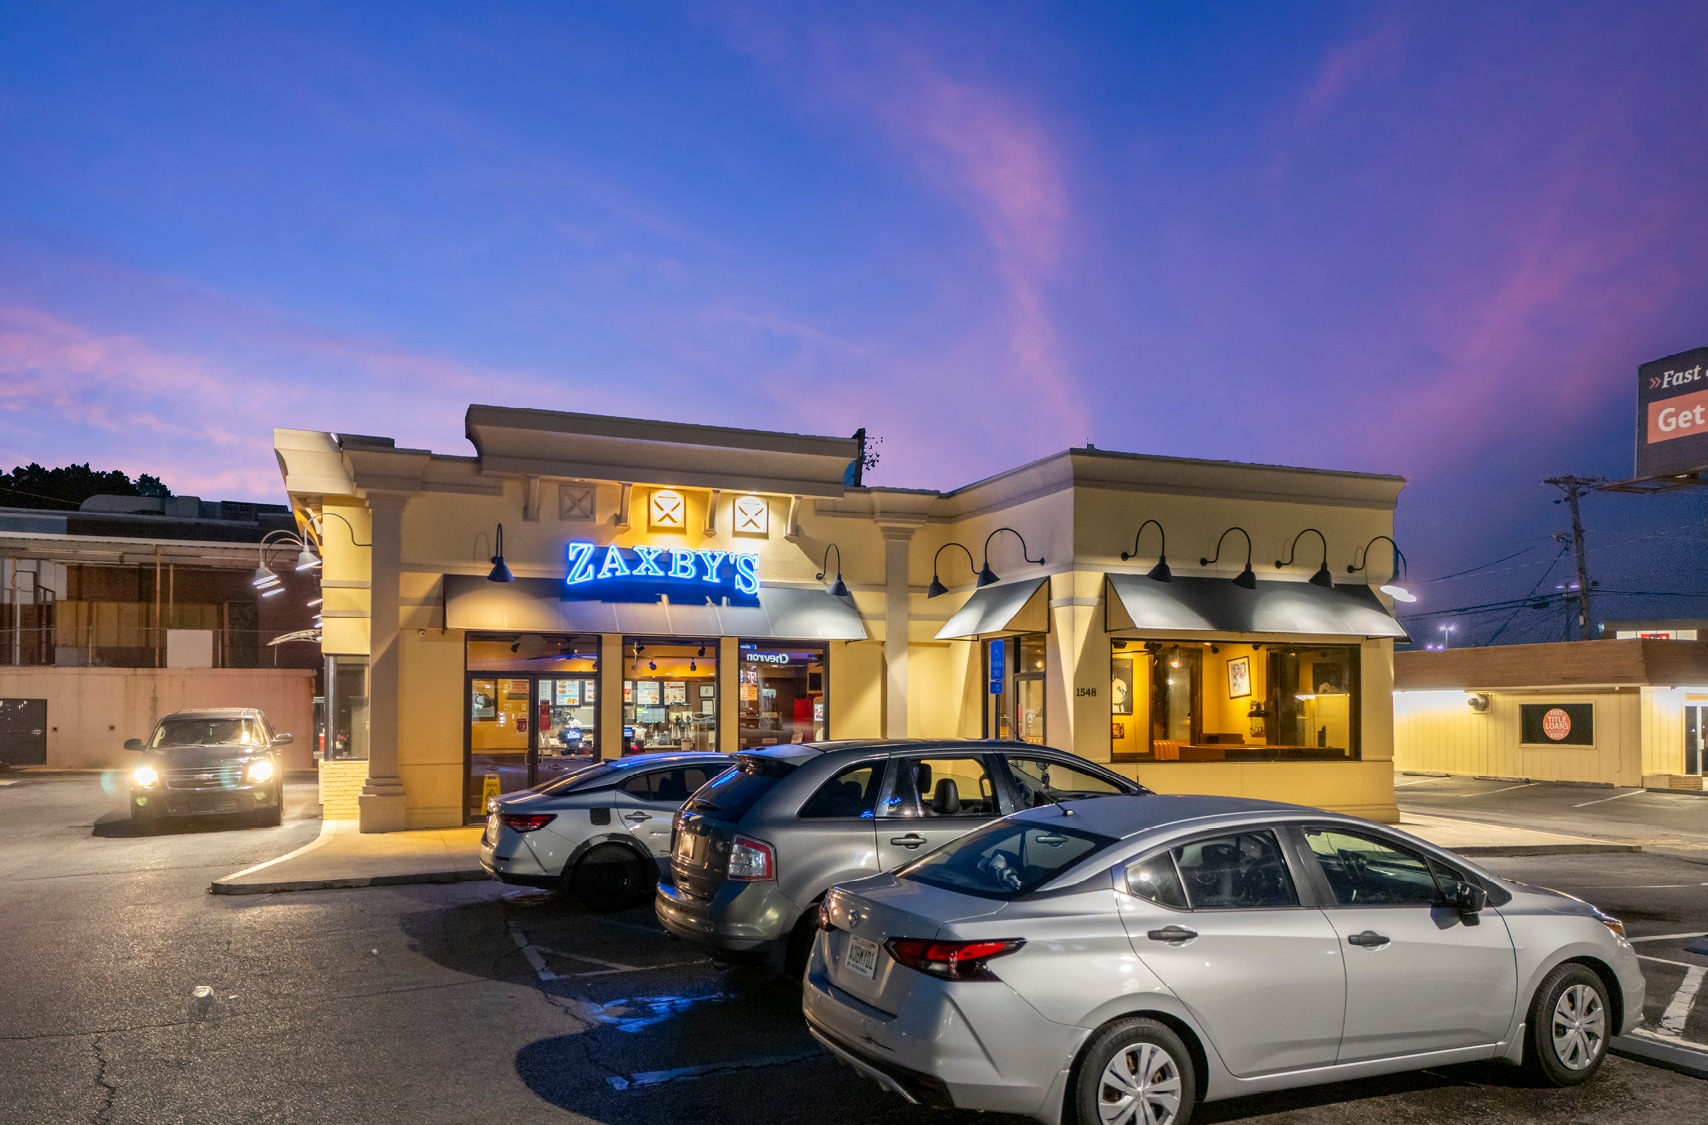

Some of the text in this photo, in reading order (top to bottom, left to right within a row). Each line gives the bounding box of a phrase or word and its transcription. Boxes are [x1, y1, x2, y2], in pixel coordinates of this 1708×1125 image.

[1661, 364, 1702, 389] Fast
[1658, 404, 1706, 432] Get
[566, 542, 761, 595] ZAXBY'S
[1076, 688, 1097, 697] 1548
